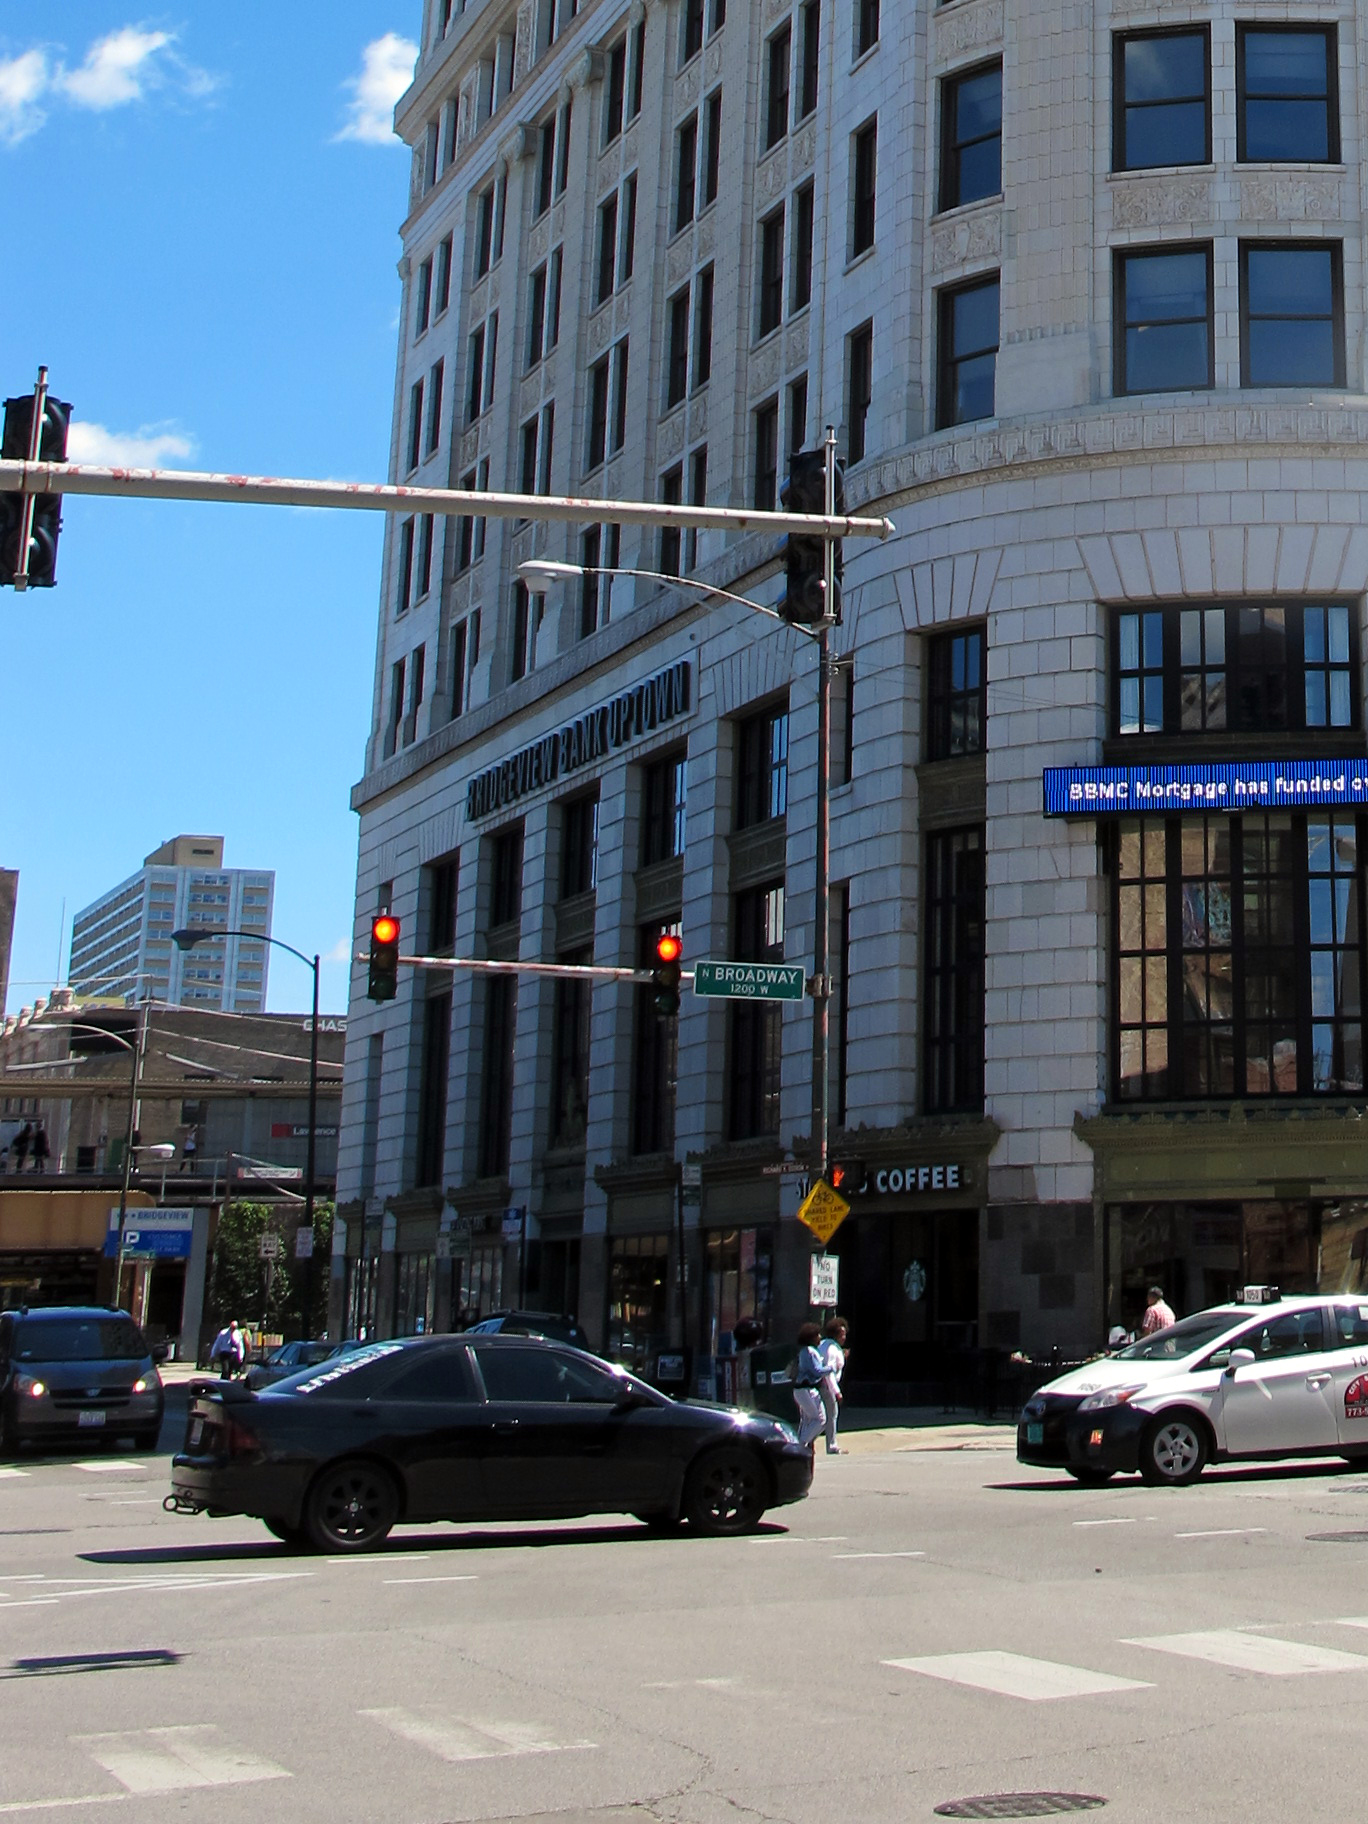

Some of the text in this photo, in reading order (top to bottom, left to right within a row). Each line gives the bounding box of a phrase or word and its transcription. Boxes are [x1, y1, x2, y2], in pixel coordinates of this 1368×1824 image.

[467, 660, 691, 822] BRIDGEVIEW BANK UPTOWN
[1069, 782, 1129, 800] BBMC
[1136, 780, 1228, 801] Mortgage
[1235, 776, 1269, 794] has
[1276, 774, 1345, 794] funded
[702, 967, 798, 984] N BROADWAY
[731, 983, 769, 995] 1200 W
[303, 1019, 348, 1032] CHAS
[293, 1126, 336, 1136] Lawence
[876, 1165, 959, 1193] COFFEE
[819, 1261, 831, 1271] NO
[816, 1276, 833, 1285] TURN
[813, 1288, 836, 1299] ON RED
